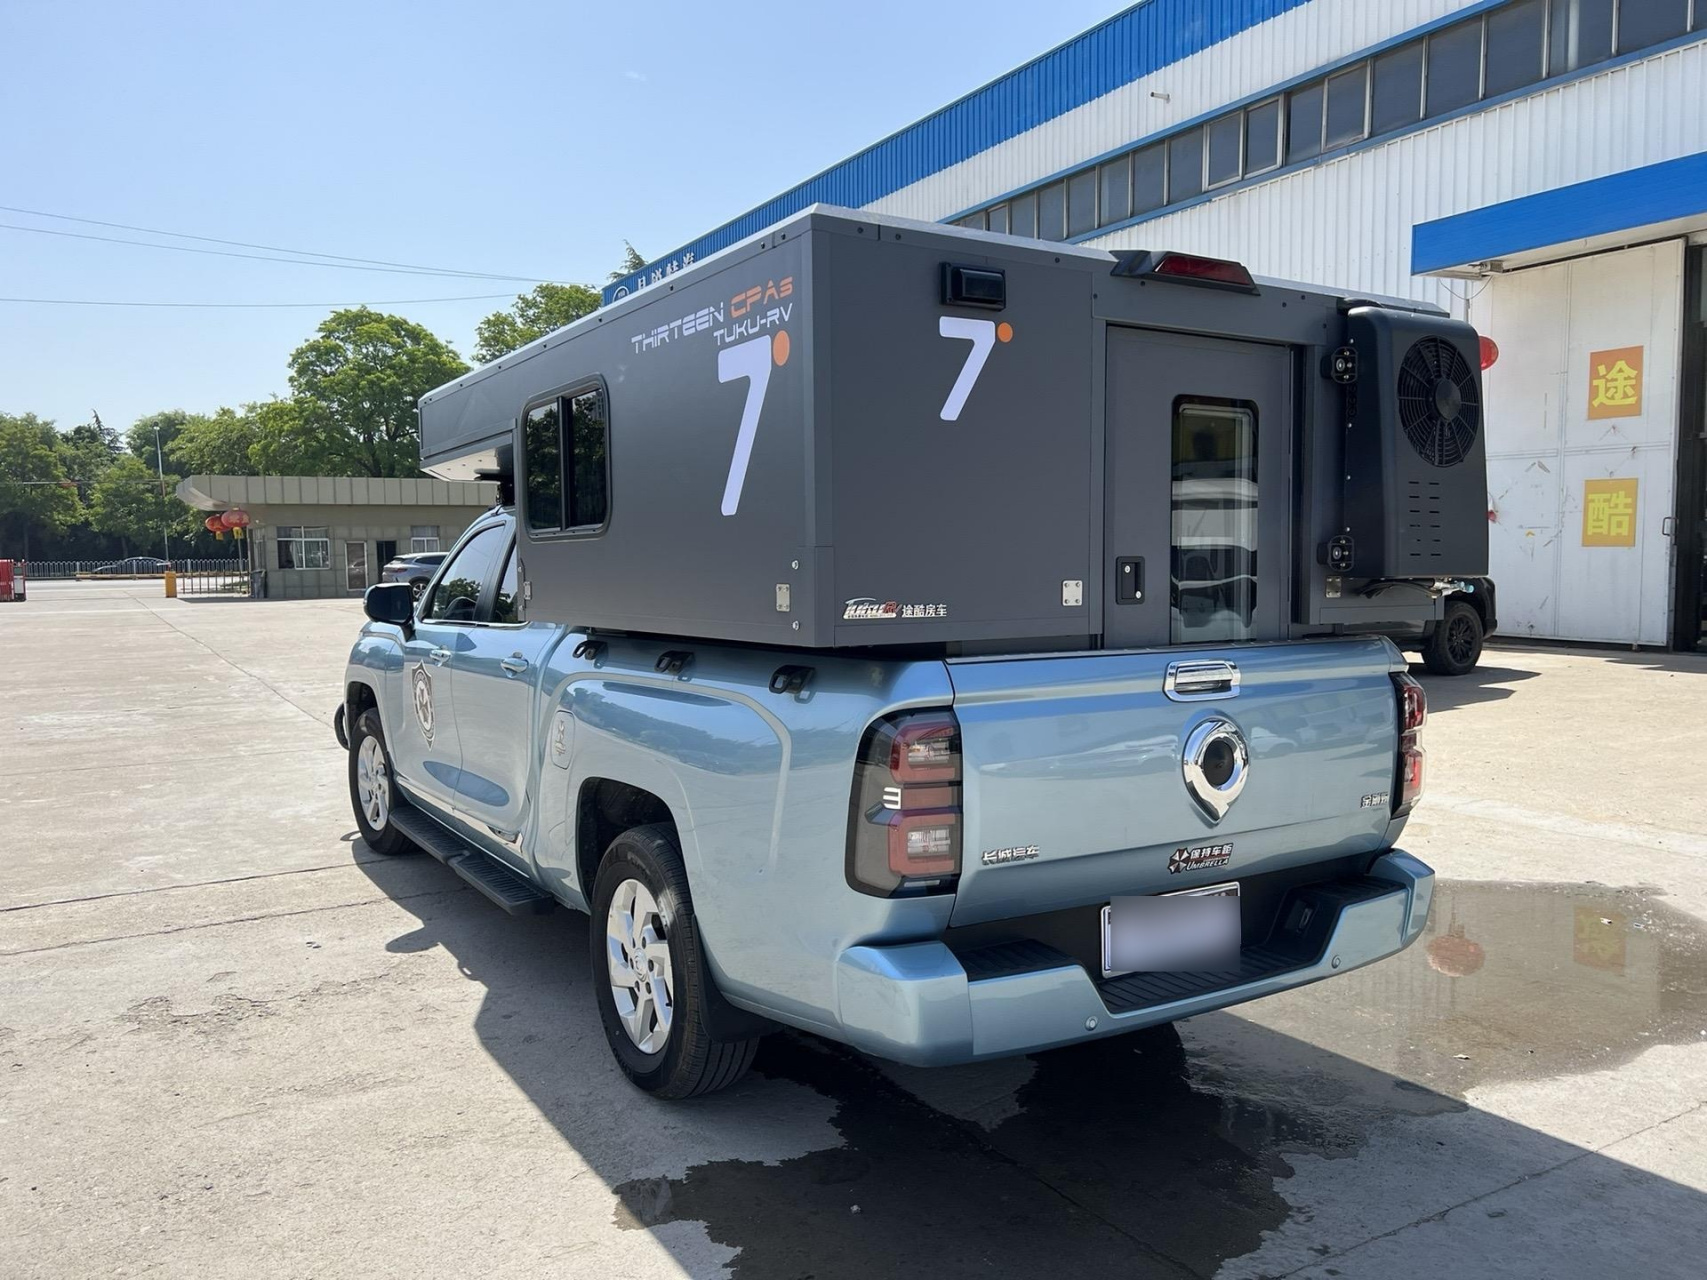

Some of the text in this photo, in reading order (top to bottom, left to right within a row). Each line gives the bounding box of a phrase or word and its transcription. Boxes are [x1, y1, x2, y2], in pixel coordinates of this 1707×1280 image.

[631, 302, 724, 354] THIRTEEN
[713, 302, 793, 346] TUKU-RV
[1592, 359, 1639, 408] 途
[1587, 490, 1633, 537] 酷
[901, 603, 948, 618] 途酷房车
[1190, 843, 1233, 859] 保持车距
